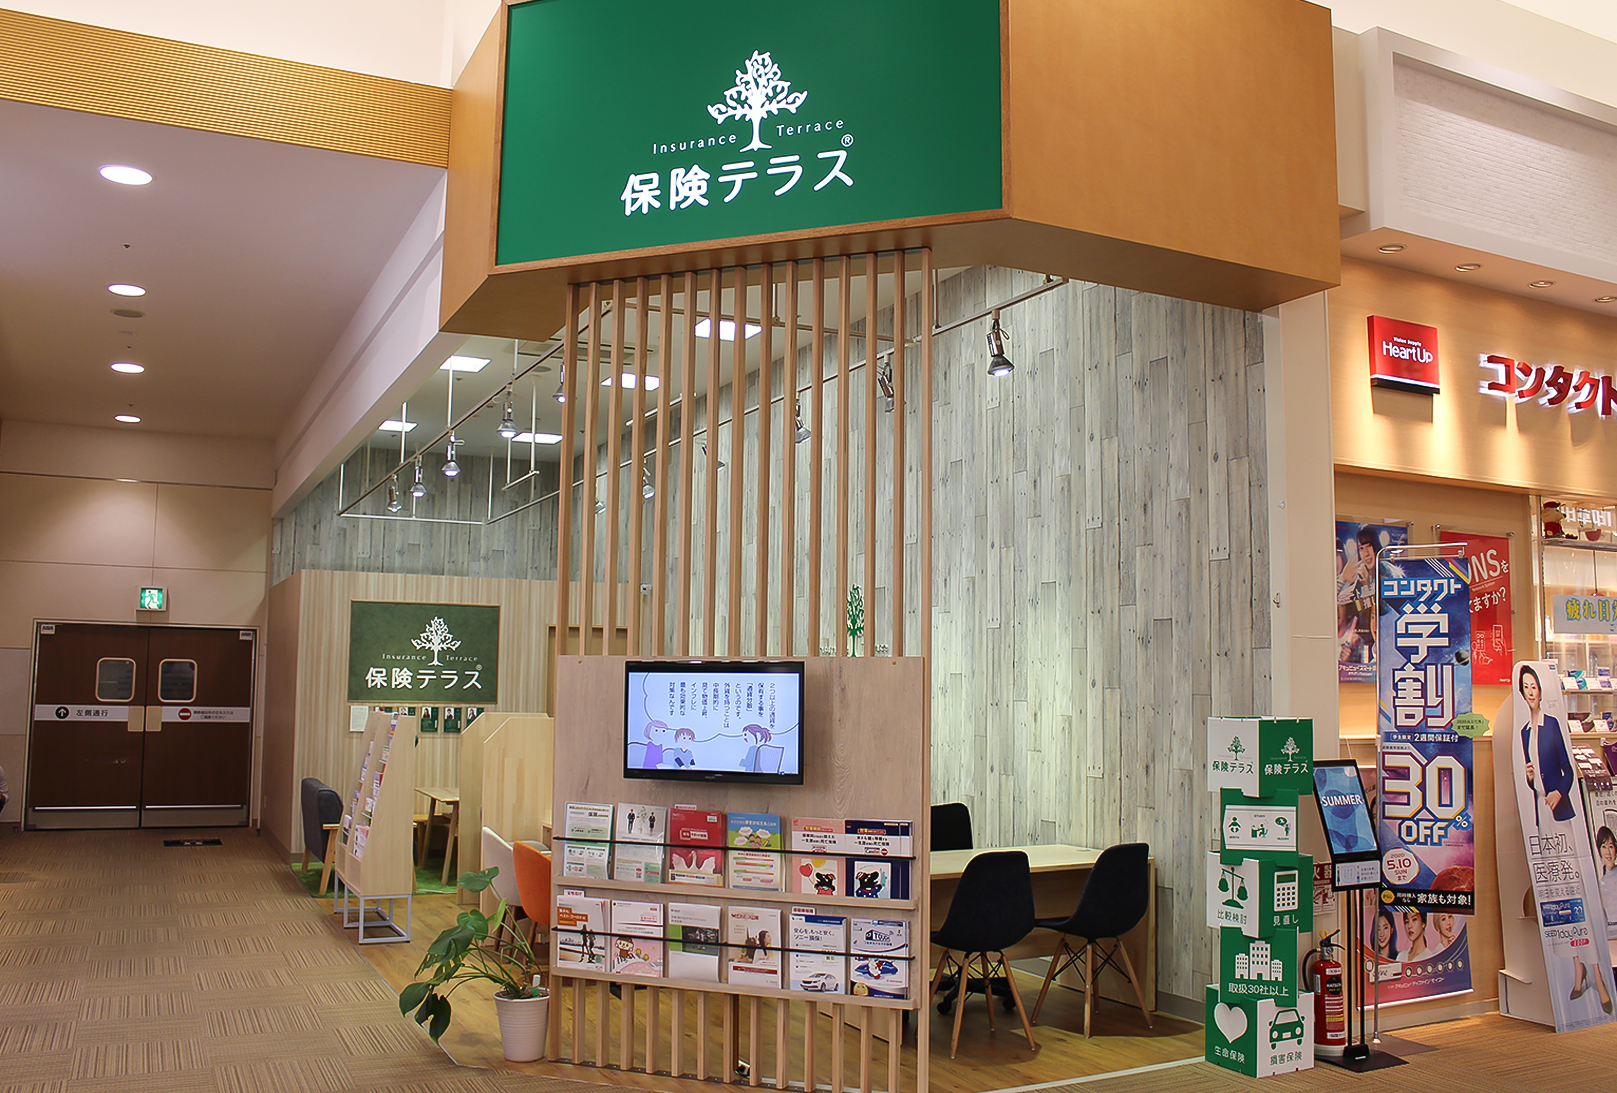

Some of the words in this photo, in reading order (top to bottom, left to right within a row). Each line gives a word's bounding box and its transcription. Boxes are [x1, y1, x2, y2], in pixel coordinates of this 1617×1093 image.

[653, 134, 737, 155] Insurance
[776, 119, 844, 137] Terrace
[620, 149, 855, 217] 保険テラス
[1383, 579, 1462, 602] コンタクト
[382, 653, 427, 661] Insurance
[445, 654, 479, 662] Terrace
[365, 667, 482, 690] 保険テラス
[76, 709, 109, 717] 左側通行
[1212, 760, 1254, 774] 保険テラス
[1264, 763, 1309, 776] 保険テラス
[1384, 753, 1465, 819] 30
[1322, 794, 1363, 807] SUMMER
[1400, 820, 1449, 844] OFF
[1386, 858, 1412, 870] 5.10
[1417, 892, 1471, 905] 家族も対象!
[1216, 909, 1248, 925] 比較検討
[1273, 914, 1299, 927] 見直し
[1228, 983, 1289, 997] 取扱30社以上
[1214, 1045, 1246, 1064] 生命保険
[1269, 1050, 1303, 1066] 損害保険
